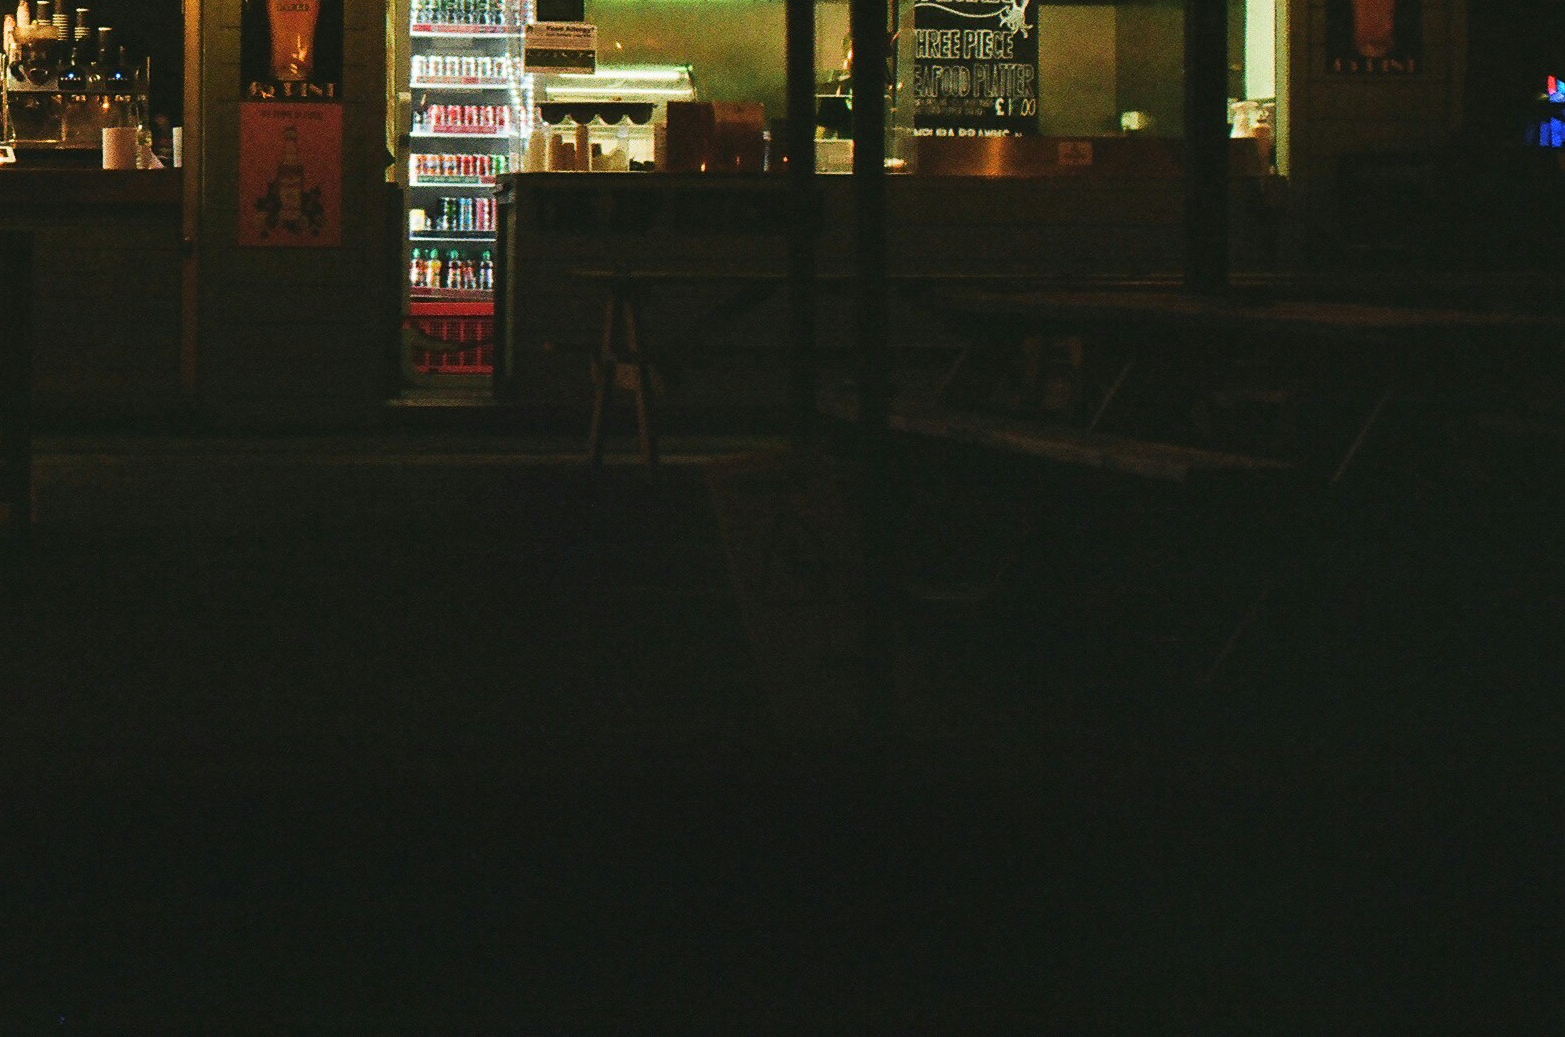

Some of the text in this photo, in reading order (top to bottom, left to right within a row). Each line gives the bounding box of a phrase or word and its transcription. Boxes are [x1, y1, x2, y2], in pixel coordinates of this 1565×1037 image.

[914, 29, 1014, 59] HREE PIECE
[914, 63, 1035, 98] EAFOOD PLATTER
